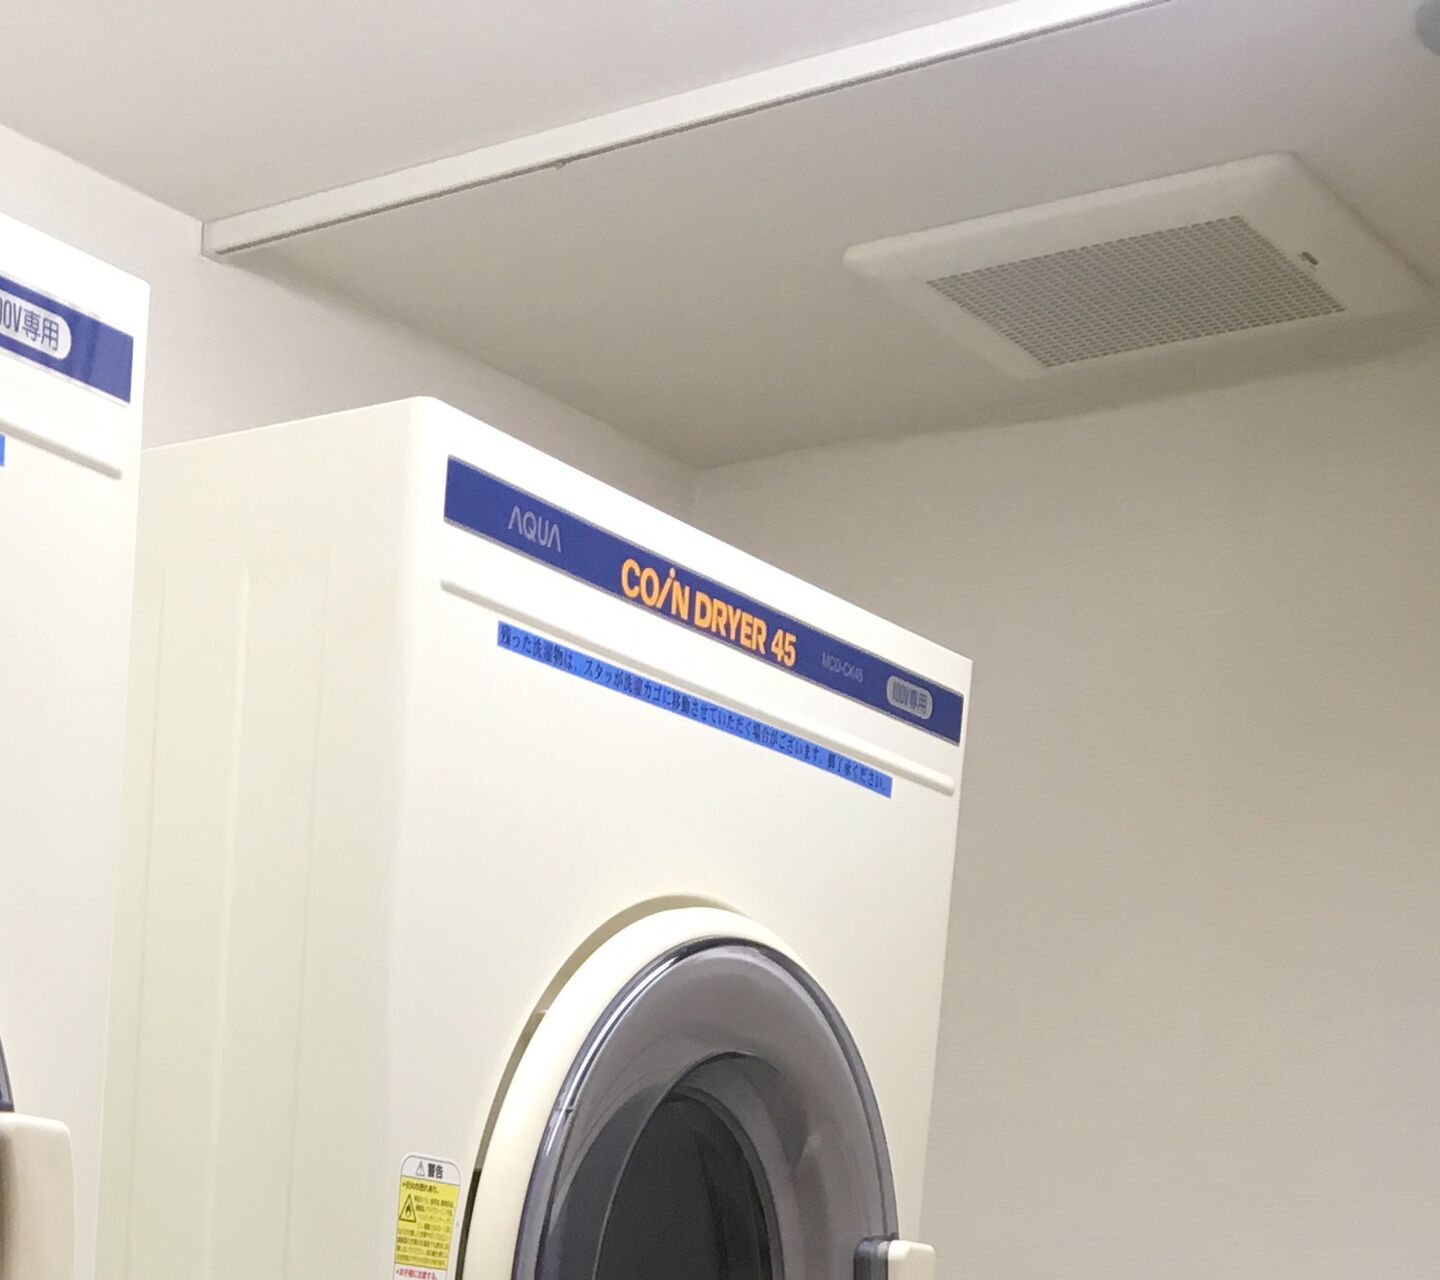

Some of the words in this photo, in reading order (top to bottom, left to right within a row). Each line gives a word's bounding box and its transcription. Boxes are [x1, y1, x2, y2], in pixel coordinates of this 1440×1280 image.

[508, 505, 562, 554] AQUA
[695, 591, 767, 655] DRYER
[770, 633, 797, 668] 45
